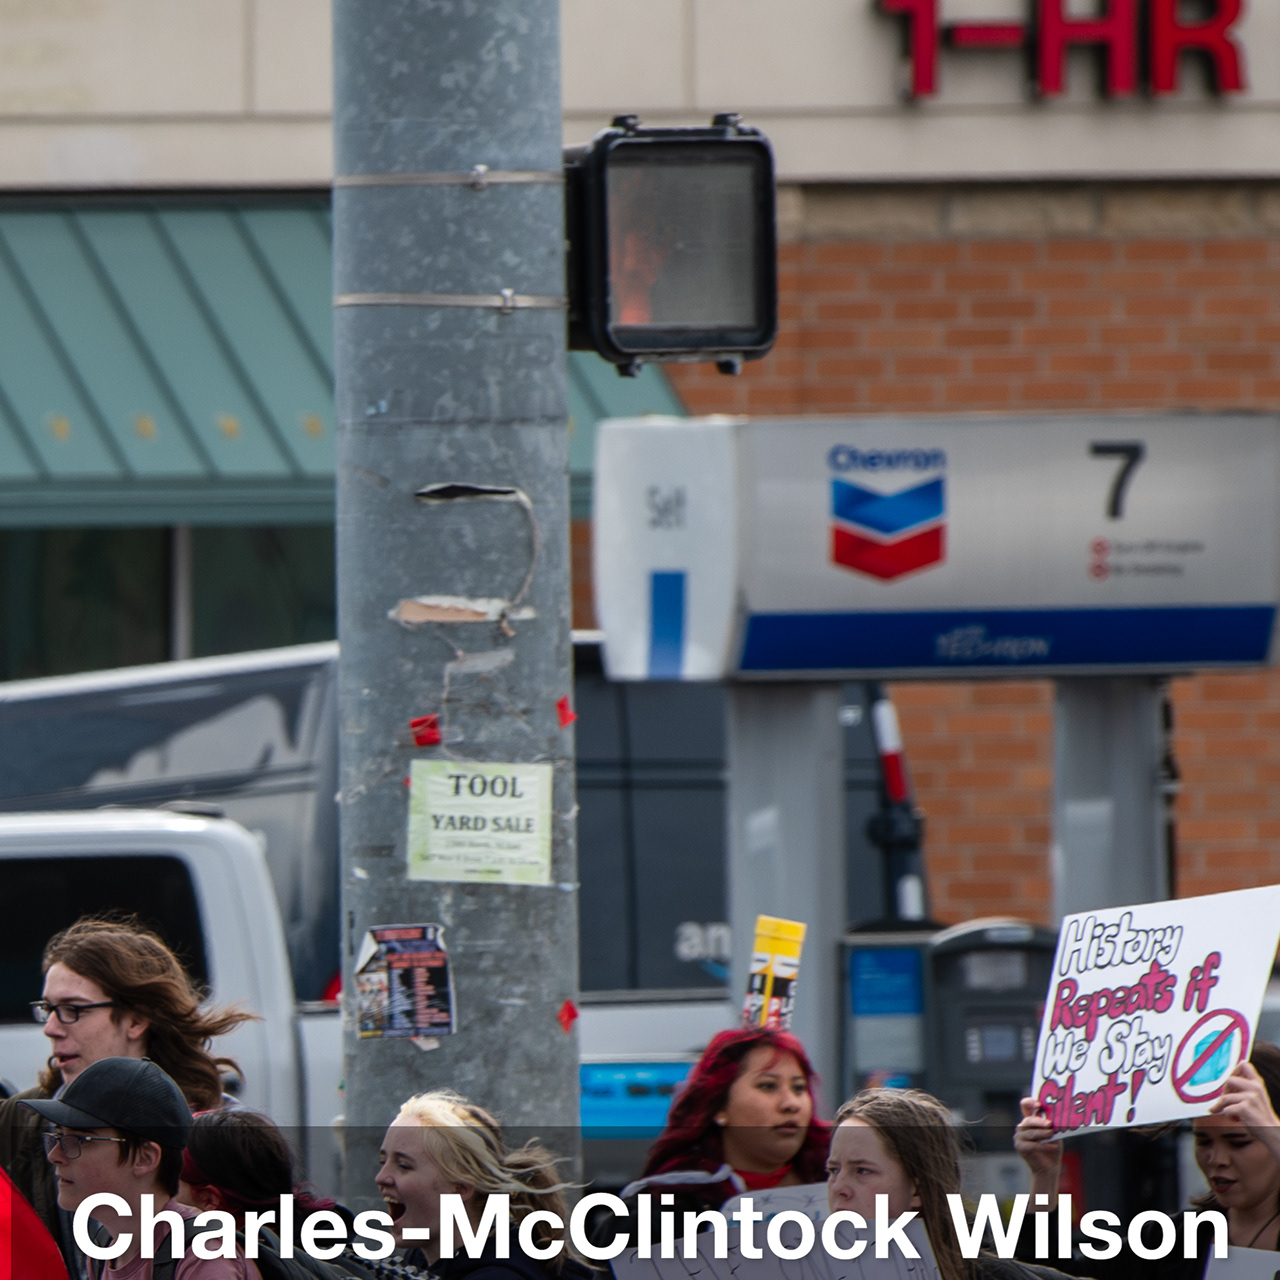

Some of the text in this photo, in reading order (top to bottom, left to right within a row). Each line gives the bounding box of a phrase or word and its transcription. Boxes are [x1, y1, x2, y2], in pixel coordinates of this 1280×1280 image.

[828, 445, 946, 473] Chevron
[1088, 441, 1146, 519] 7
[448, 774, 524, 798] TOOL
[431, 814, 536, 834] YARD SALE
[1058, 911, 1184, 977] History
[1050, 951, 1222, 1042] Repeats if
[1041, 1015, 1173, 1085] We Stay
